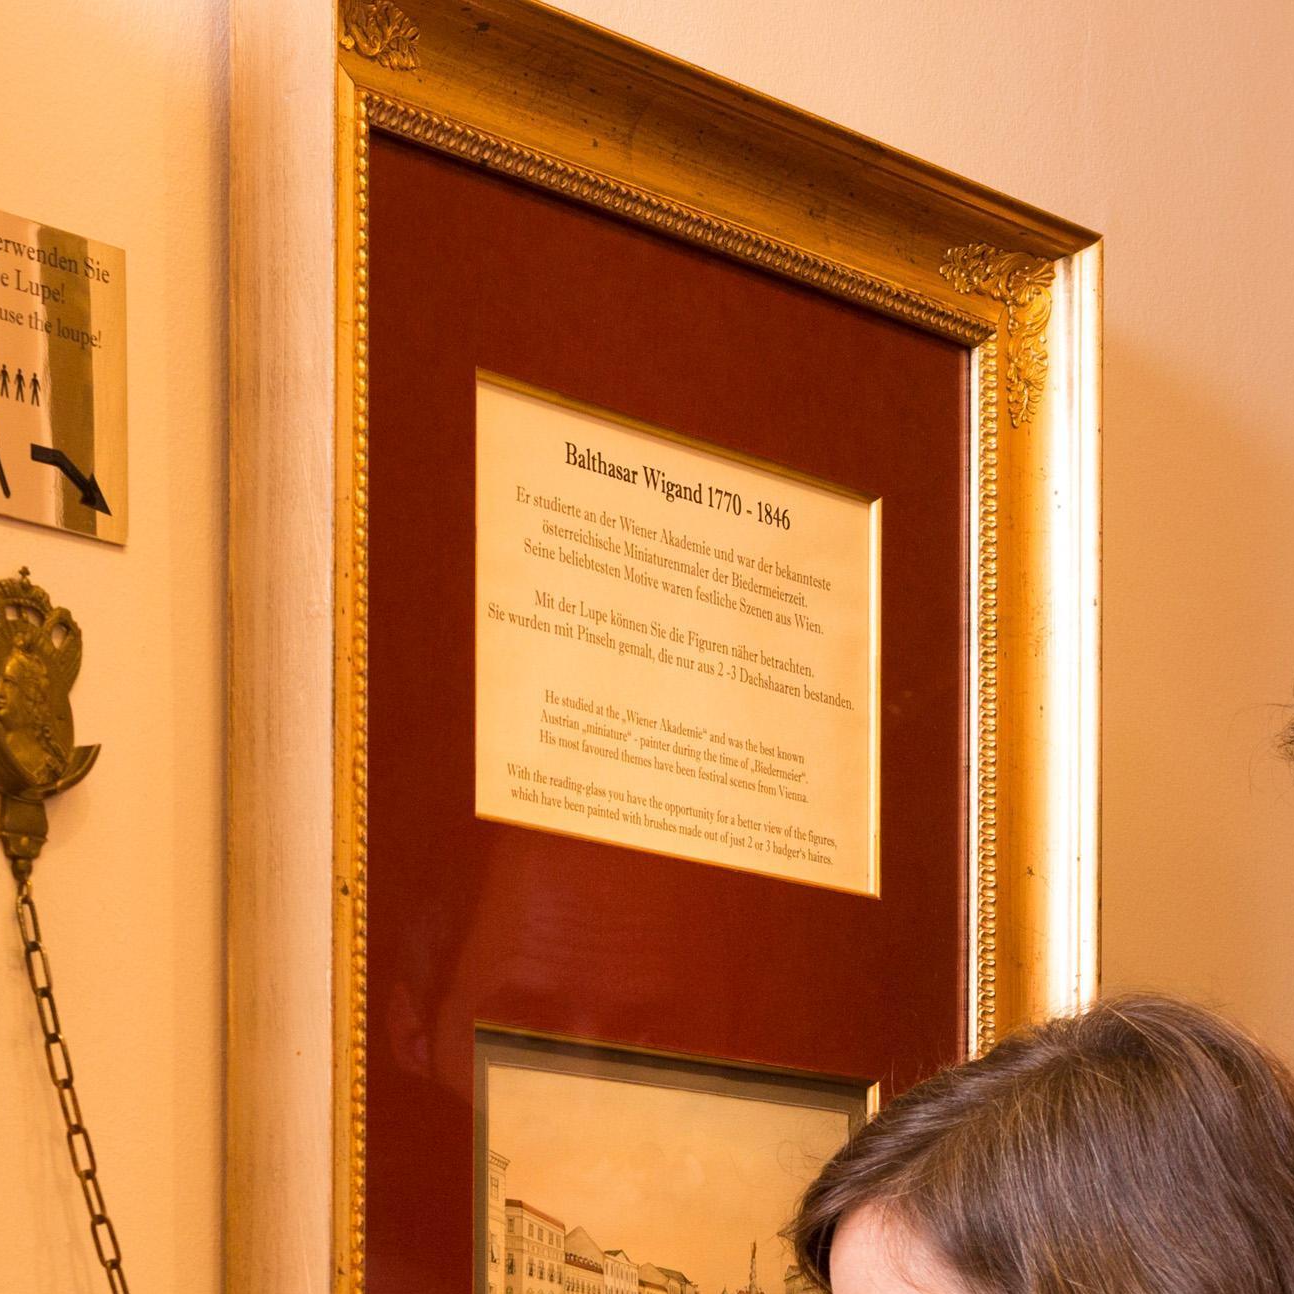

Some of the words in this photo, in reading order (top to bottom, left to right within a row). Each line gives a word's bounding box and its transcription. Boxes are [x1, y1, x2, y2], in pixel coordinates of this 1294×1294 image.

[16, 269, 66, 305] Lupe!
[83, 256, 111, 284] Sie
[29, 312, 52, 334] the
[58, 318, 102, 350] loupe!
[564, 441, 638, 483] Balthasar
[642, 465, 703, 504] Wigand
[707, 486, 742, 515] 1770
[757, 501, 791, 530] 1846
[515, 484, 531, 504] Er
[532, 495, 581, 518] studierte
[583, 510, 597, 523] an
[599, 510, 617, 528] der
[619, 515, 658, 540] Wiener
[659, 528, 711, 556] Akademie
[713, 547, 734, 563] und
[736, 554, 756, 568] war
[757, 556, 773, 574] der
[774, 561, 831, 591] bekannteste
[541, 519, 621, 553] österreichische
[623, 541, 710, 578] Miniaturenmaler
[711, 567, 729, 584] der
[731, 571, 808, 607] Biedermeierzeit.
[523, 537, 556, 560] Seine
[558, 546, 621, 578] beliebtesten
[623, 564, 659, 589] Motive
[661, 580, 693, 598] waren
[695, 585, 737, 610] festliche
[739, 597, 773, 621] Szenen
[775, 612, 792, 626] aus
[794, 612, 824, 634] Wien.
[487, 601, 506, 621] Sie
[507, 612, 551, 632] wurden
[554, 622, 574, 638] mit
[576, 624, 616, 649] Pinseln
[618, 641, 655, 661] gemalt,
[657, 647, 674, 664] die
[675, 656, 695, 670] nur
[696, 661, 715, 675] aus
[739, 667, 801, 697] Dachshaaren
[803, 684, 855, 710] bestanden.
[534, 589, 555, 609] Mit
[557, 596, 577, 614] der
[579, 600, 608, 625] Lupe
[610, 609, 648, 634] können
[650, 620, 667, 639] Sie
[668, 626, 685, 644] die
[687, 630, 729, 655] Figuren
[731, 644, 759, 663] näher
[759, 649, 814, 677] betrachten.
[539, 728, 557, 745] His
[557, 737, 580, 751] most
[581, 739, 619, 760] favoured
[620, 747, 652, 768] themes
[653, 755, 675, 772] have
[675, 760, 696, 778] been
[697, 766, 728, 785] festival
[728, 777, 756, 791] scenes
[757, 779, 777, 796] from
[545, 688, 560, 705] He
[561, 696, 594, 713] studied
[595, 705, 604, 716] at
[605, 704, 620, 720] the
[709, 731, 726, 745] and
[727, 737, 744, 749] was
[744, 738, 758, 752] the
[758, 740, 775, 757] best
[776, 745, 805, 764] known
